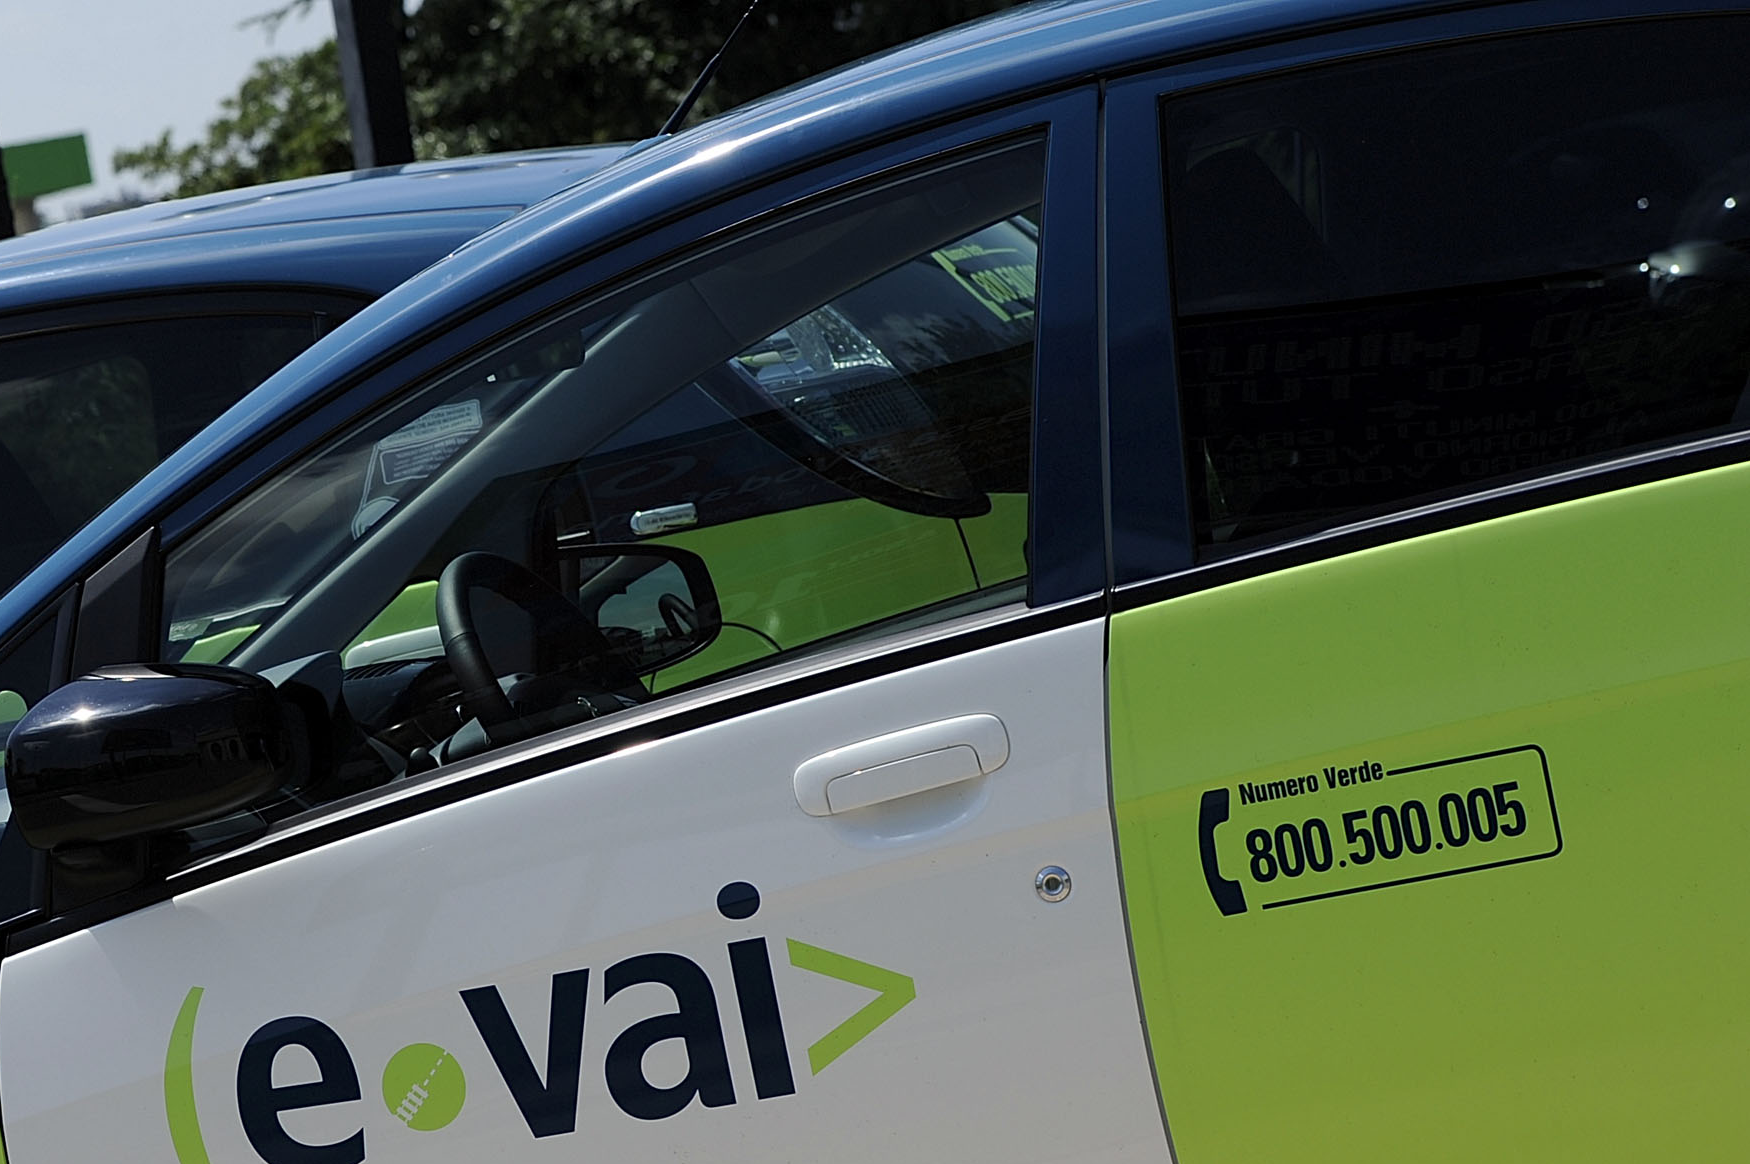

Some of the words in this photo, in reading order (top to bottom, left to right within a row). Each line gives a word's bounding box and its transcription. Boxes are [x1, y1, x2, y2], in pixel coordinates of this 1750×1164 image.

[1238, 775, 1319, 805] Numero
[1323, 760, 1384, 789] Verde
[1246, 781, 1527, 883] 800.500.005
